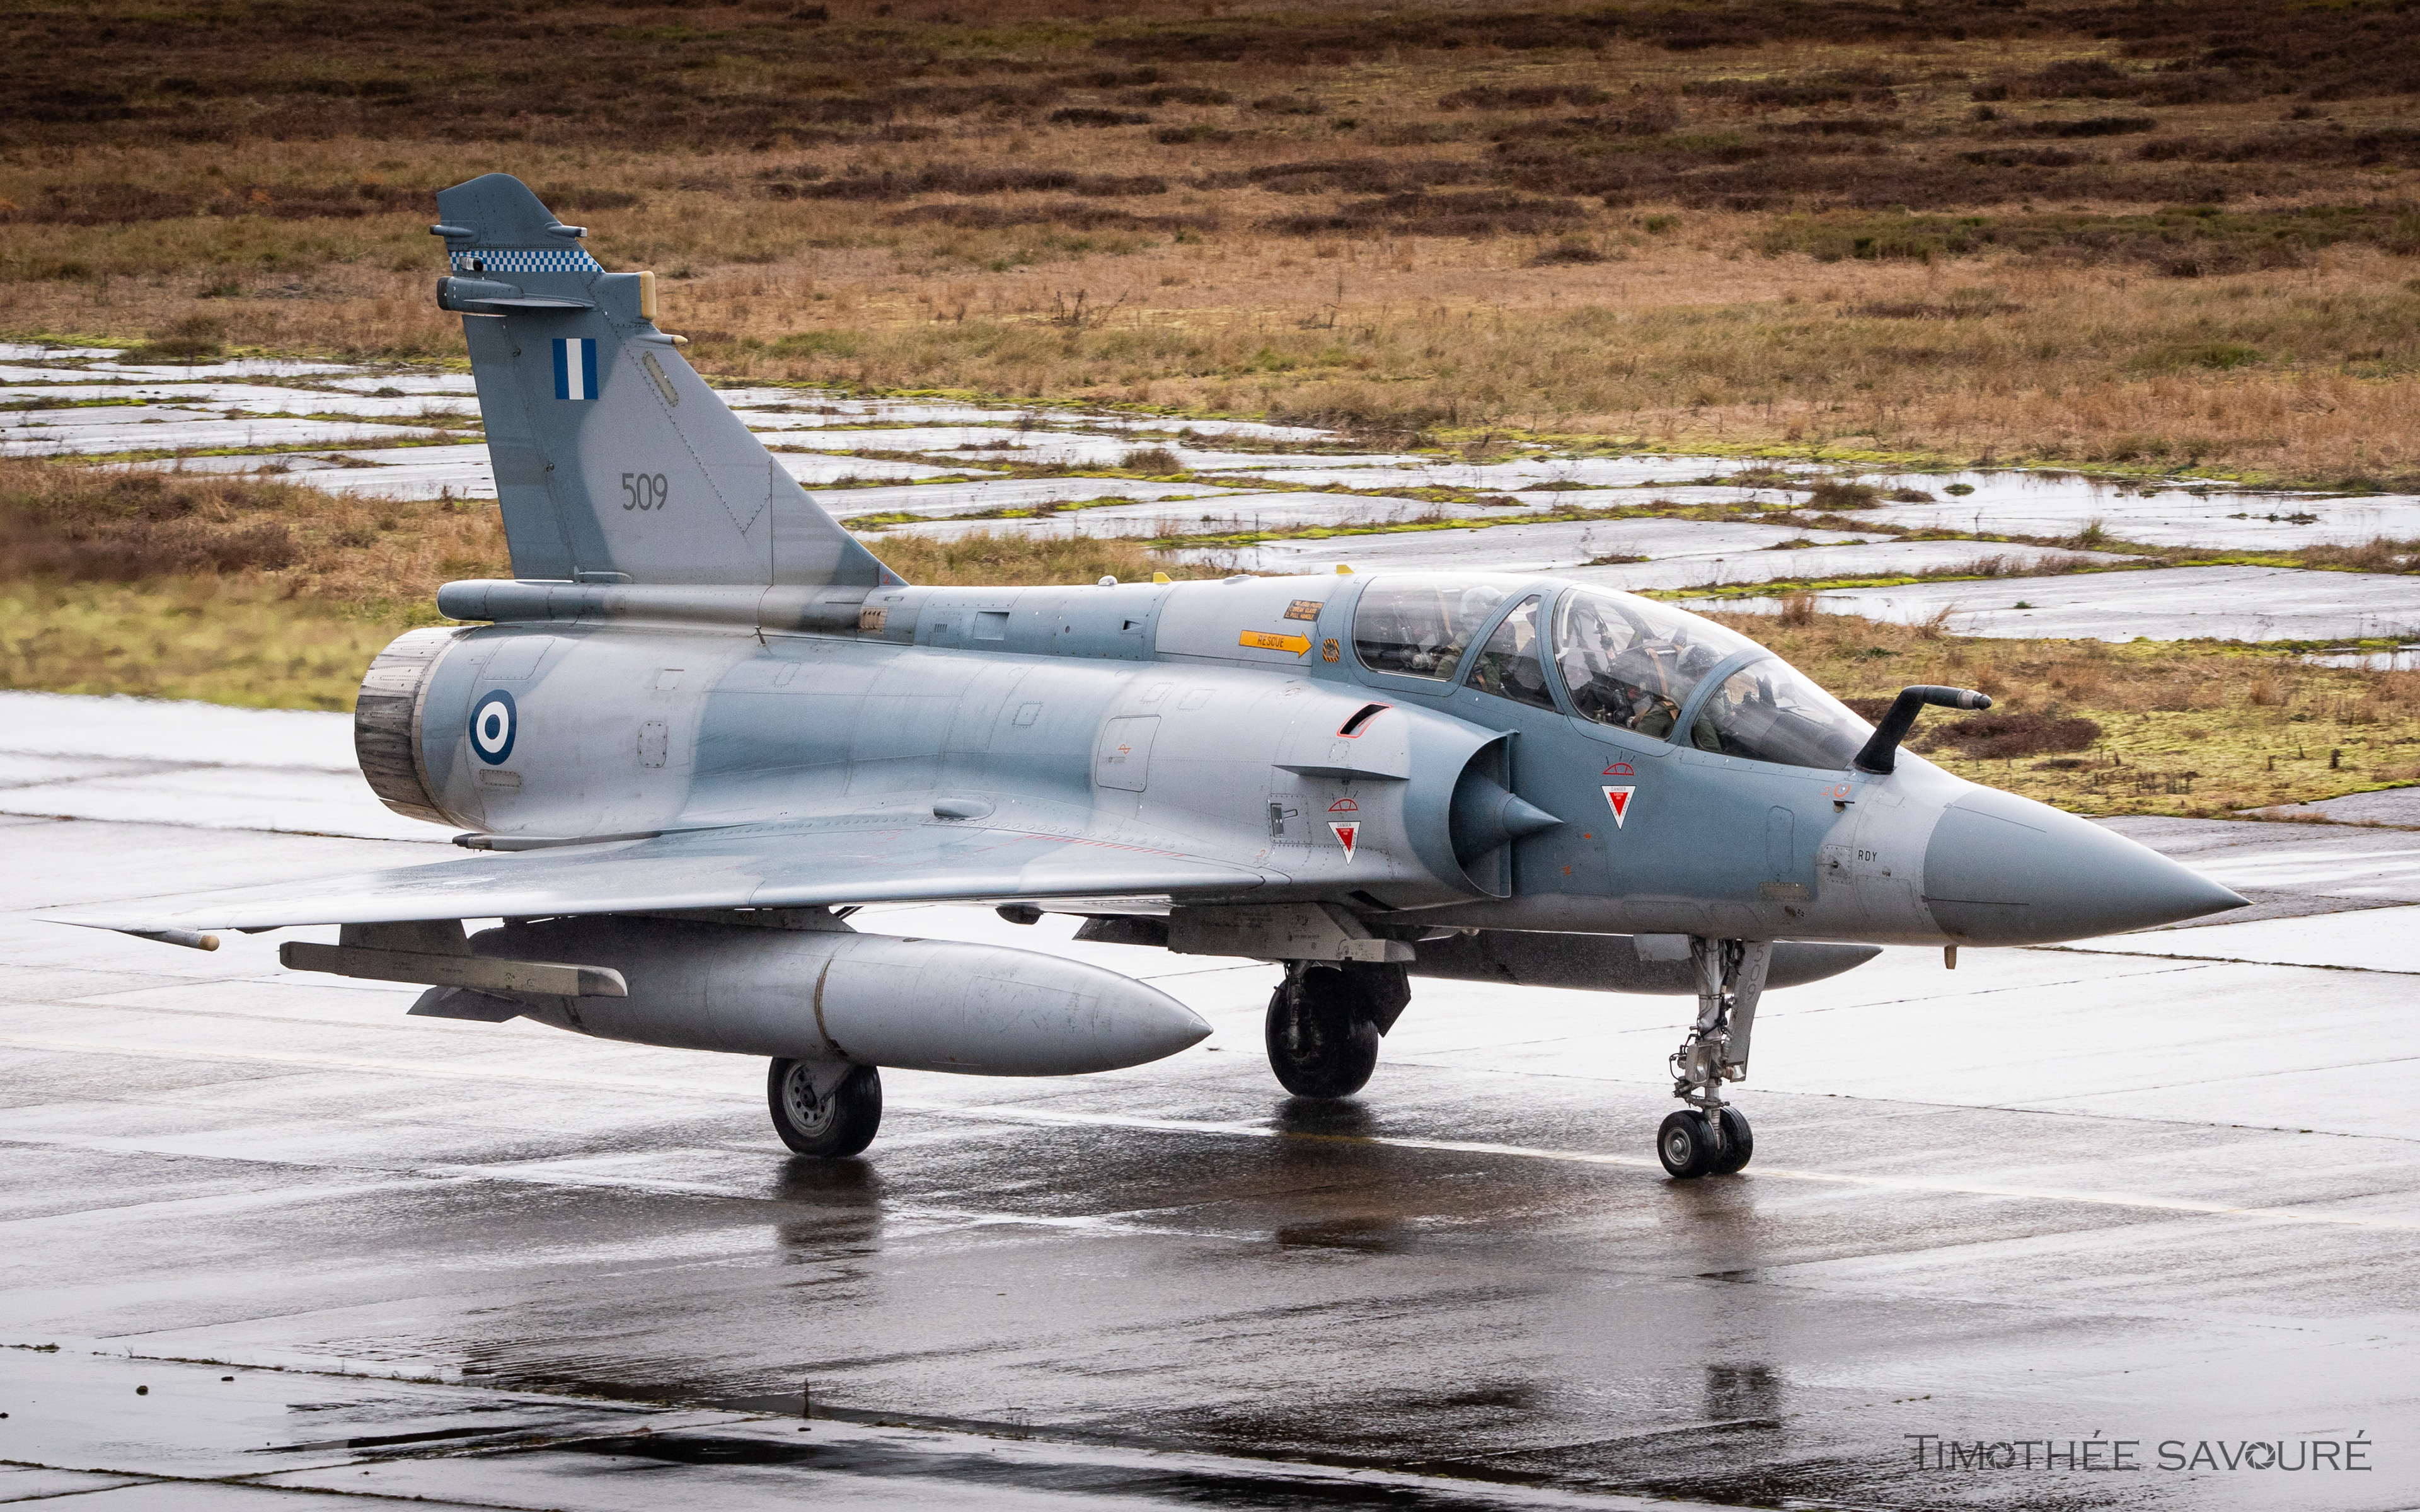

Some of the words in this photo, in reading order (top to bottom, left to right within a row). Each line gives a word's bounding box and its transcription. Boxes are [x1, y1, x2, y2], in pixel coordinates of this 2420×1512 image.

[622, 472, 668, 511] 509
[883, 574, 889, 585] 2
[1257, 635, 1284, 648] RESCUE
[1821, 786, 1830, 796] 2
[1858, 850, 1877, 862] RDY
[1747, 944, 1765, 1002] 509
